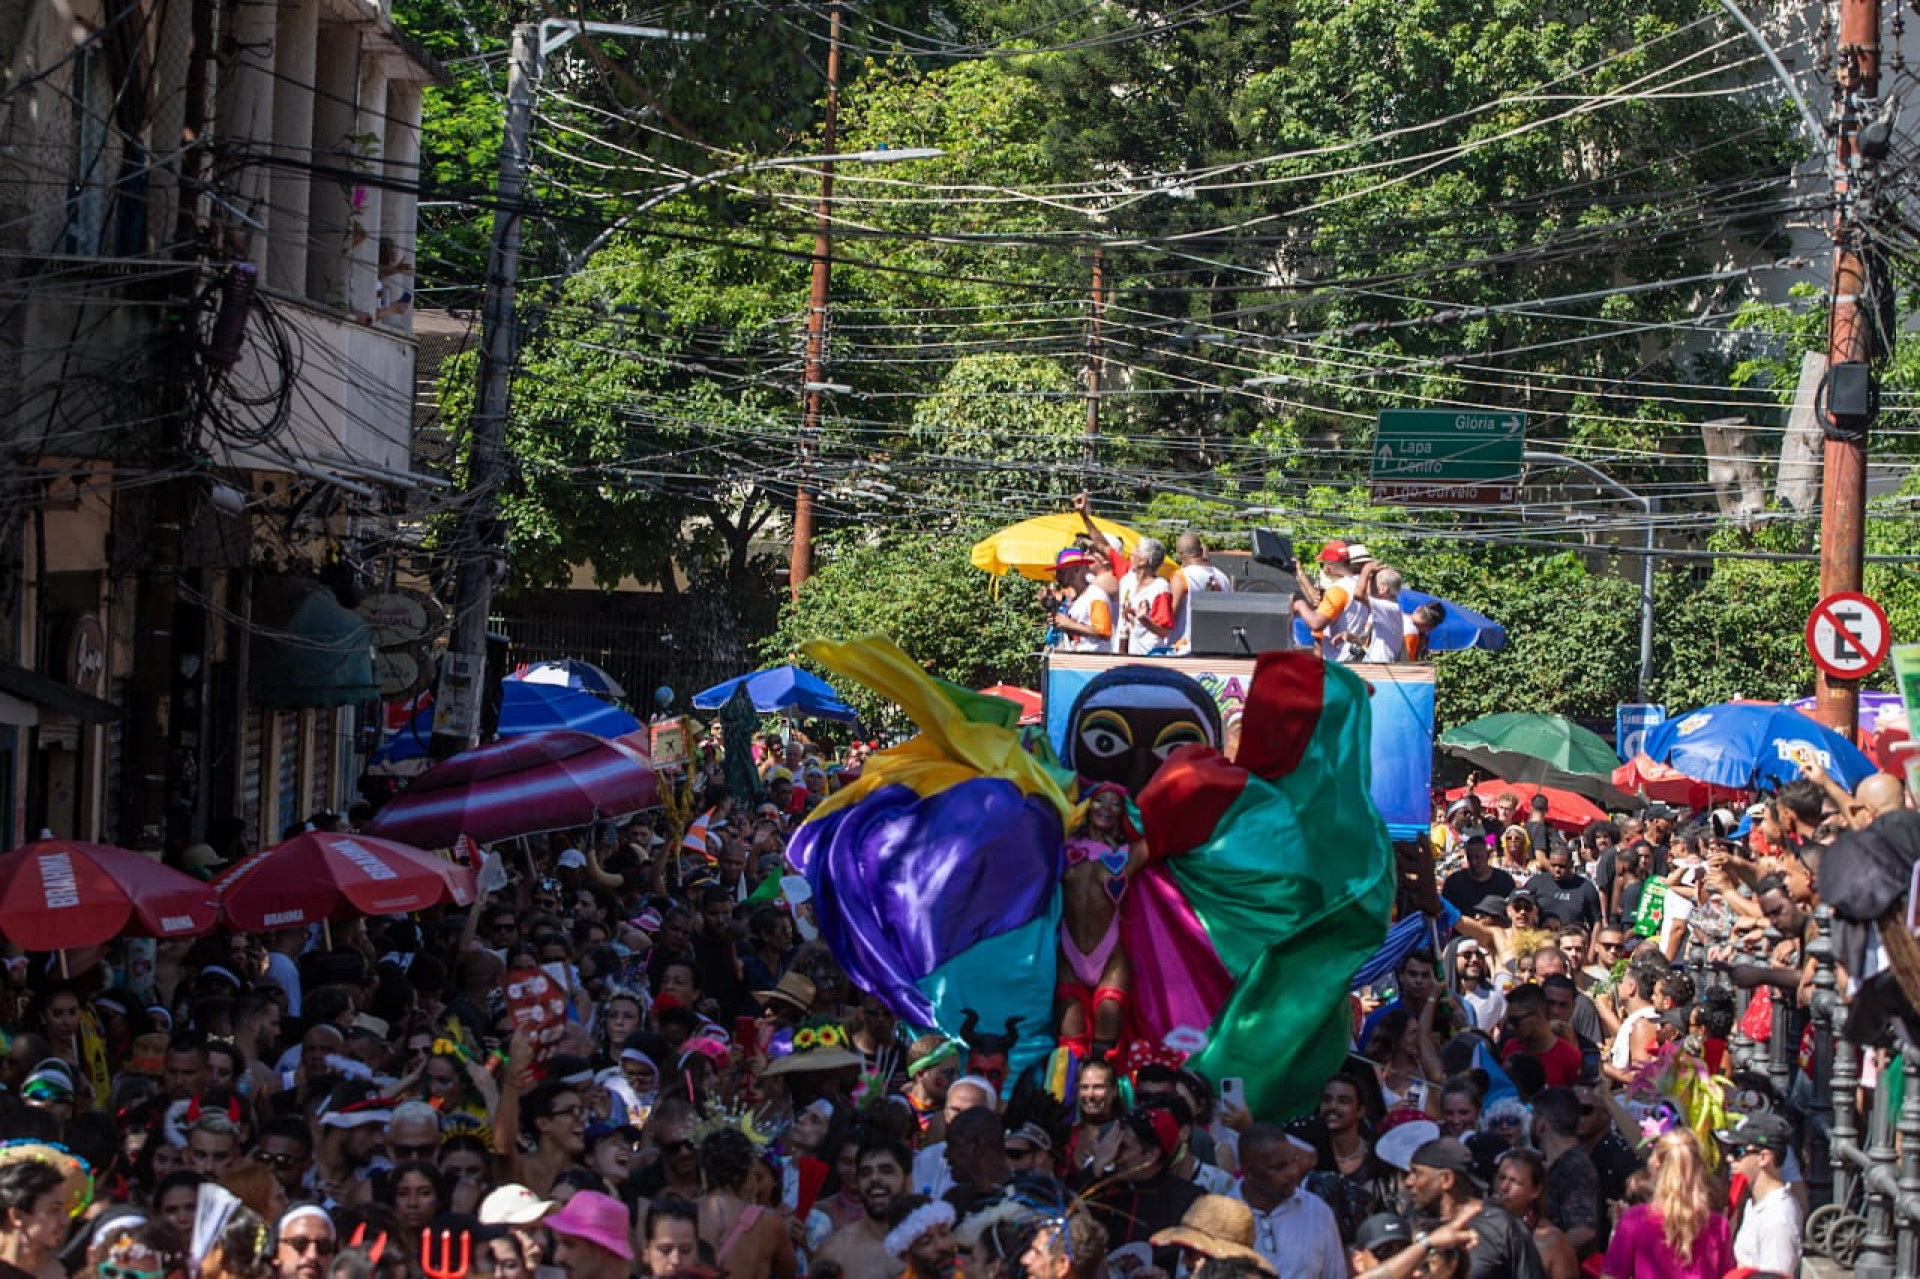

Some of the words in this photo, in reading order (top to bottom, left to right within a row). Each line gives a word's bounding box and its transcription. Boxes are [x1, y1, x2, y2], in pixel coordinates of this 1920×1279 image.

[1455, 415, 1495, 430] Glória
[1400, 441, 1432, 456] Lapa
[1397, 459, 1443, 473] Centro
[1834, 612, 1862, 659] E
[38, 852, 80, 909] BRAHMA
[263, 909, 304, 926] BRAHMA
